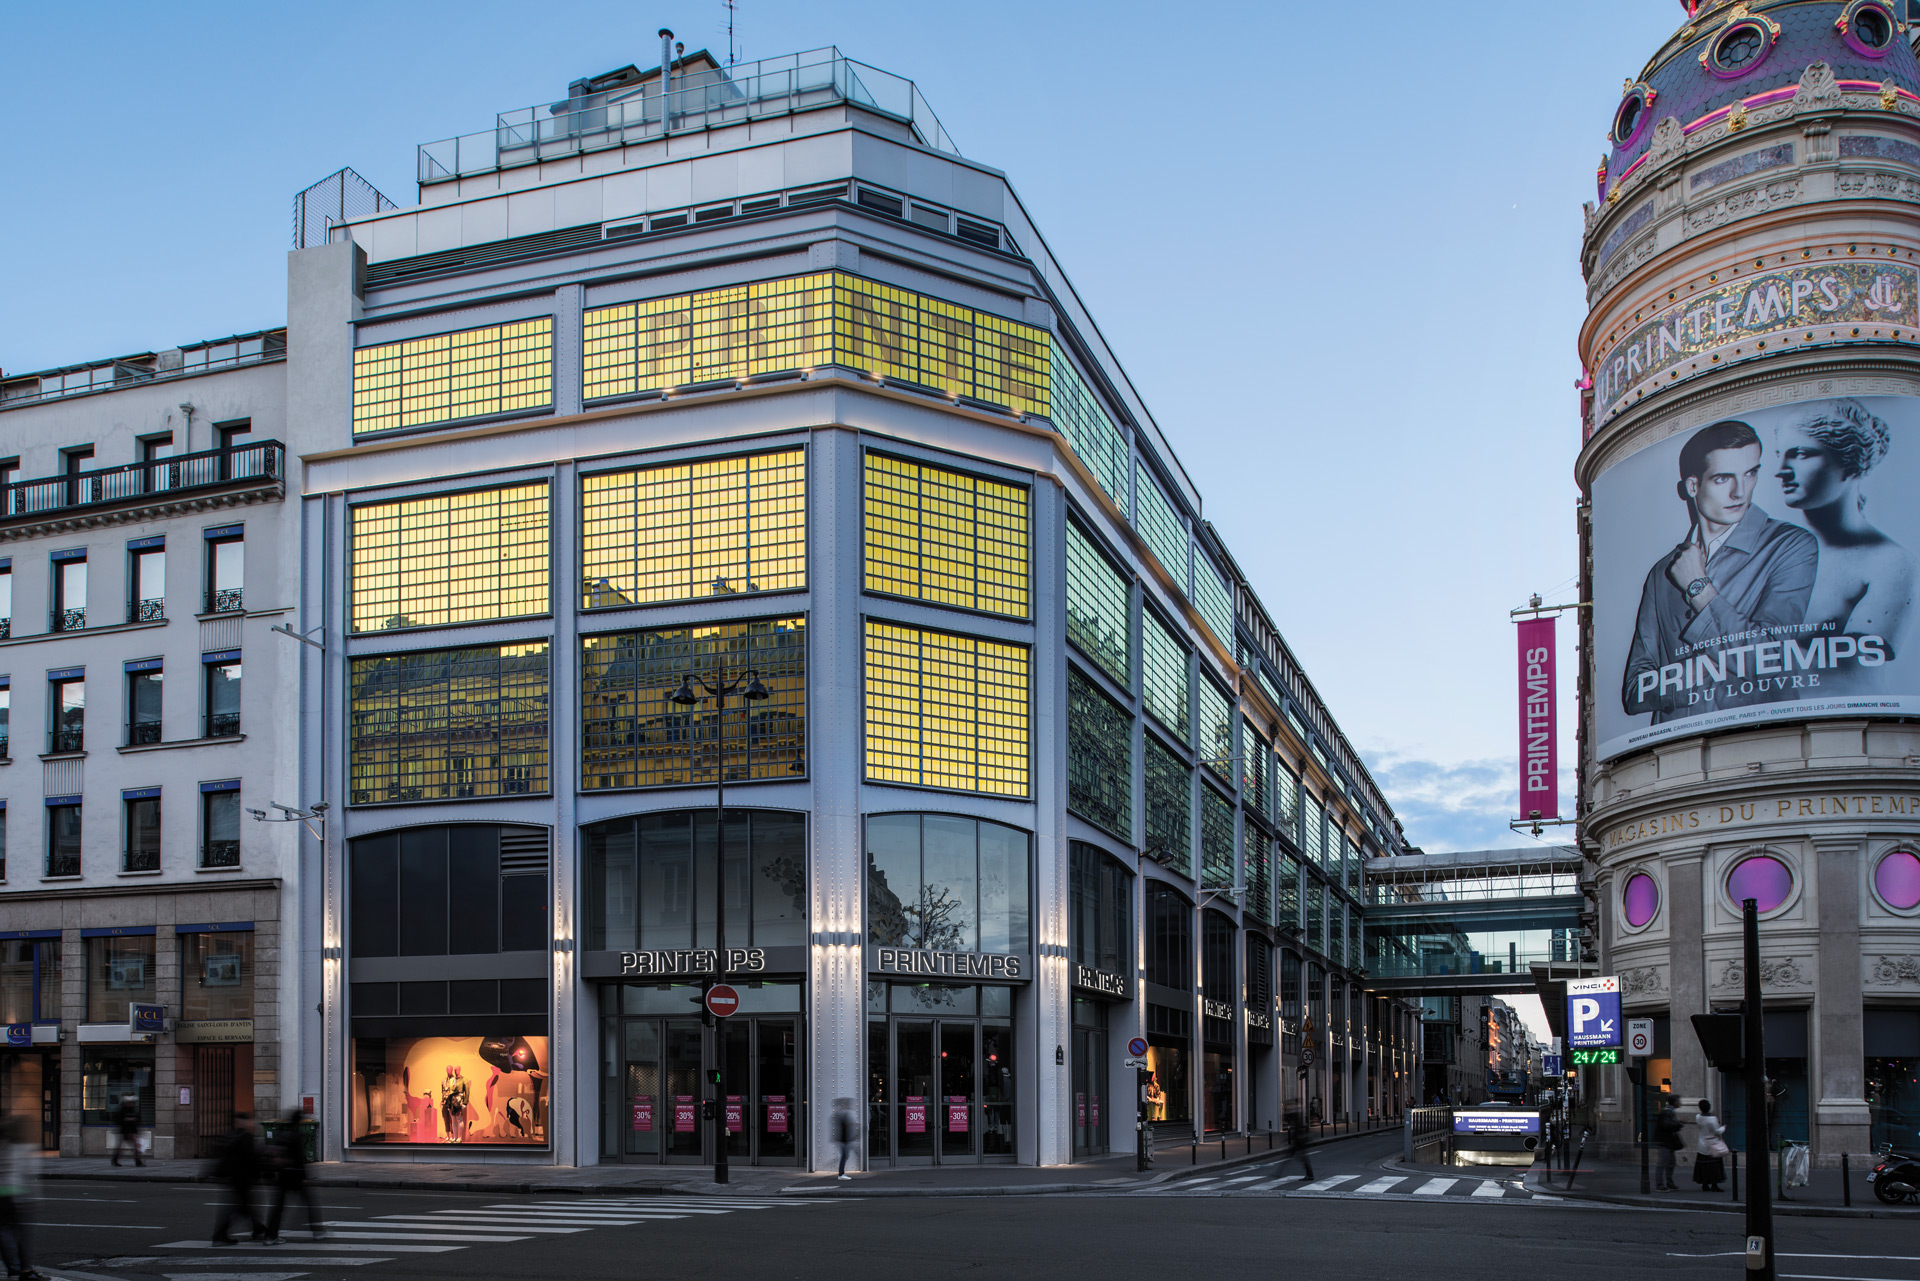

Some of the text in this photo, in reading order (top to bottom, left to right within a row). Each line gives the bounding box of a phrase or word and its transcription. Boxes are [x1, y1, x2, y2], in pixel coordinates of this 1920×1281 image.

[1614, 277, 1839, 393] PRINTEMPS
[1675, 622, 1836, 656] LES ACCESSOIRES S'INVITENT AU
[1637, 635, 1886, 703] PRINTEMPS
[1687, 674, 1821, 706] DU LOUVRE
[1526, 647, 1549, 792] PRINTEMPS
[1628, 734, 1649, 743] NOUVEAU
[1673, 721, 1704, 732] CARROUSEL
[1738, 711, 1757, 719] PARIS
[1770, 707, 1794, 715] OUVERT
[1609, 811, 1700, 848] MAGASINS
[1719, 804, 1756, 824] DU
[1777, 796, 1920, 818] PRINTEMP
[620, 948, 765, 975] PRINTEMPS
[879, 948, 1021, 978] PRINTEMPS
[1572, 983, 1600, 991] VINCI
[138, 1010, 160, 1020] LCL
[1572, 998, 1600, 1033] P
[8, 1027, 29, 1036] LCL
[1573, 1033, 1611, 1041] HAUSSMANN
[1304, 1053, 1312, 1061] 30
[634, 1111, 652, 1120] -30%
[677, 1111, 694, 1120] -30%
[770, 1112, 785, 1120] -20%
[907, 1112, 925, 1121] -30%
[950, 1112, 967, 1120] -30%
